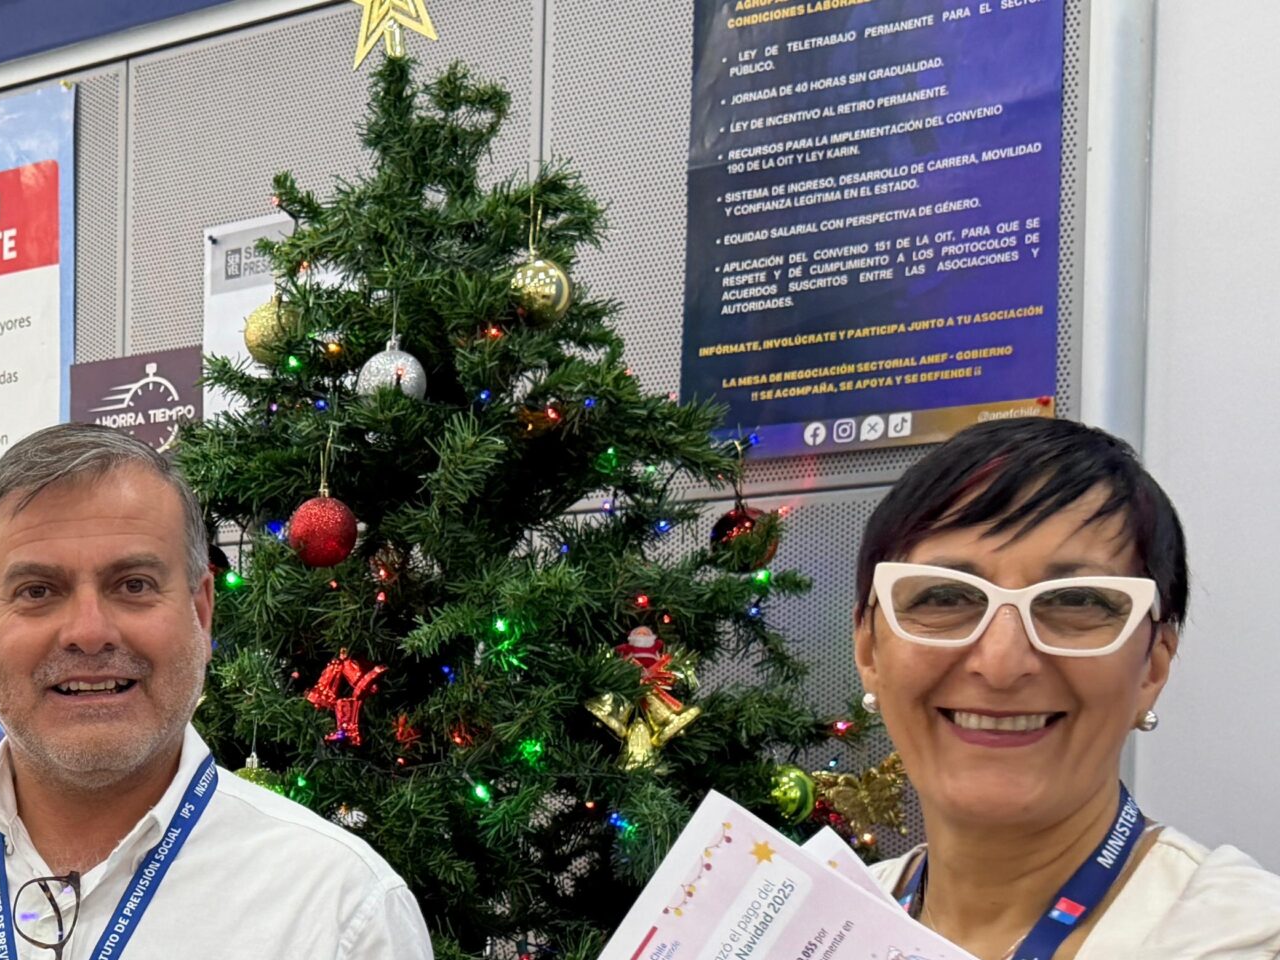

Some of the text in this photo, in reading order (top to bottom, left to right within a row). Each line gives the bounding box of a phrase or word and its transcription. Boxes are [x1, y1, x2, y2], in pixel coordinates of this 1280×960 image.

[730, 56, 944, 105] JORNADA DE 40 HORAS SIN GRADUALIDAD.
[727, 103, 1002, 160] RECURSOS PARA LA IMPLEMENTACIÓN DEL CONVENIO
[698, 305, 1043, 357] INFÓRMATE, INVOLÚCRATE Y PARTICIPA JUNTO A TU ASOCIACIÓN
[114, 916, 129, 934] DE
[122, 860, 160, 918] PREVISIÓN
[153, 826, 182, 862] SOCIAL
[179, 802, 195, 819] IPS
[729, 928, 740, 942] el
[736, 898, 763, 931] pago
[758, 879, 775, 900] del
[766, 878, 794, 914] 2025!
